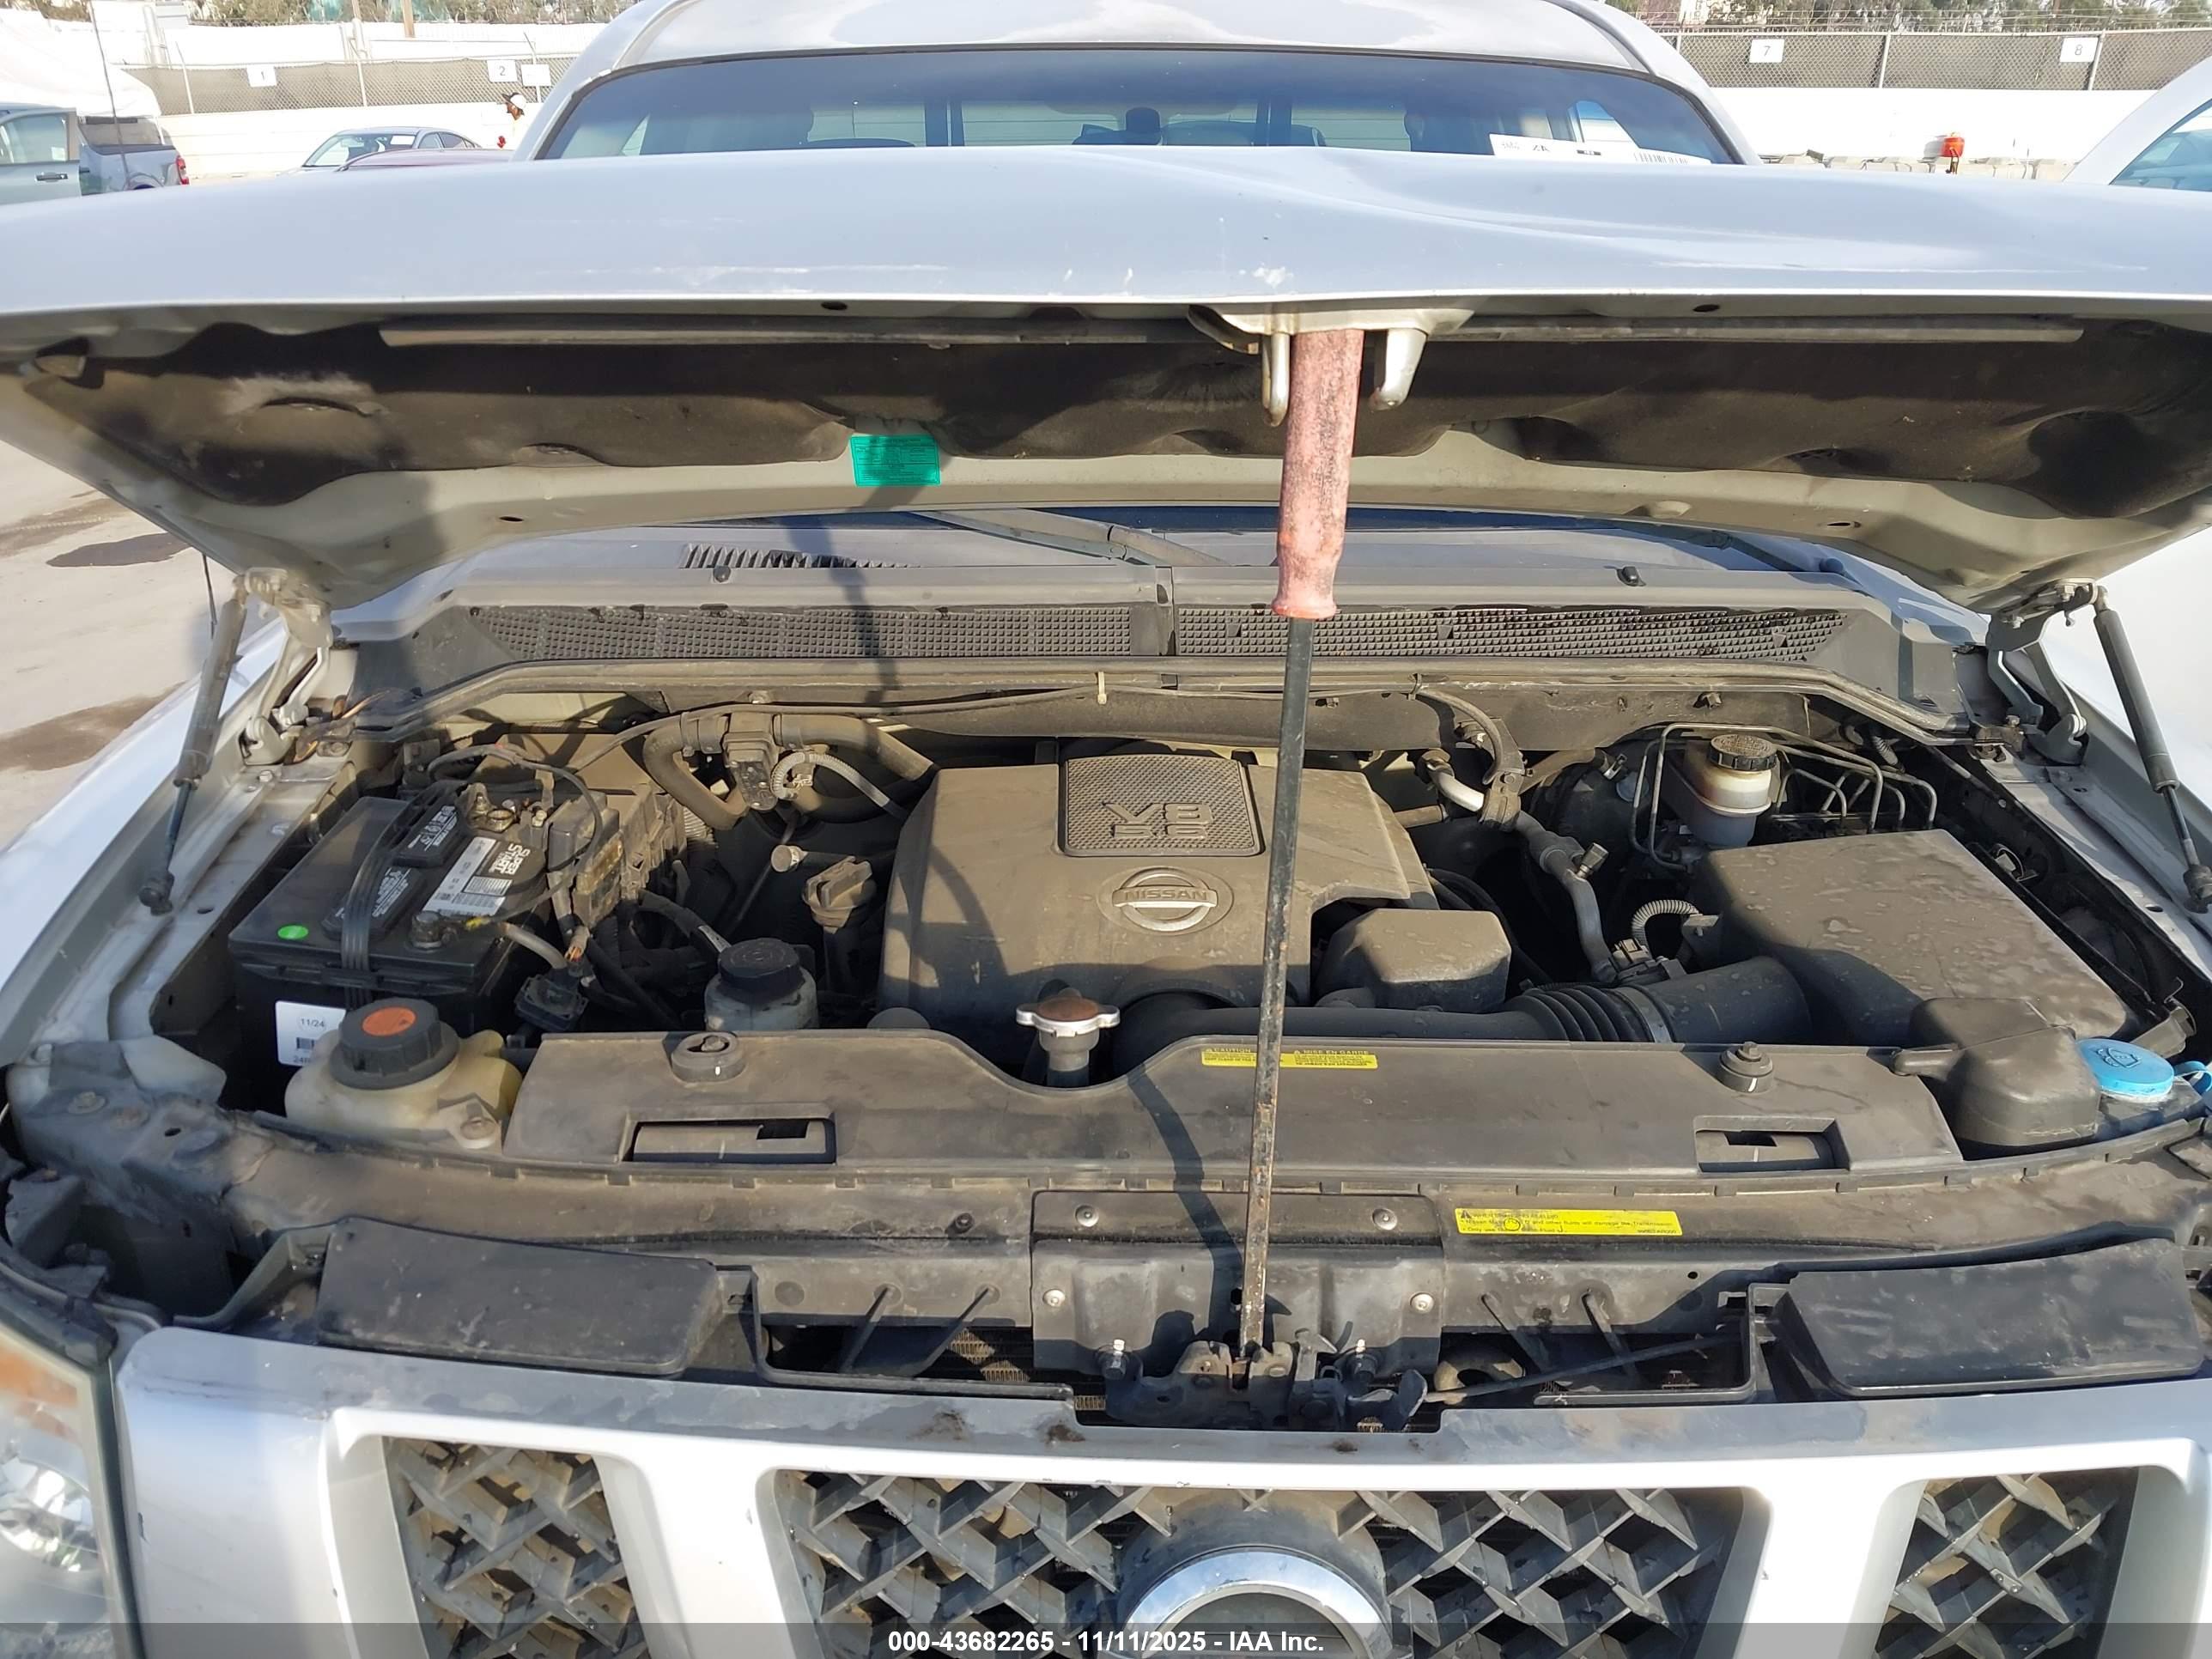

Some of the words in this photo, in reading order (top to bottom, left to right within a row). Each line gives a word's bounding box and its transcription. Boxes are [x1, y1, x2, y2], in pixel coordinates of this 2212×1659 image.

[1763, 45, 1771, 57] 7
[2074, 44, 2083, 56] 8
[498, 65, 506, 76] 2
[1102, 802, 1213, 824] V8
[495, 842, 523, 874] START
[505, 848, 531, 875] SUPER
[1124, 889, 1207, 901] NISSAN
[301, 1018, 325, 1028] 11/24
